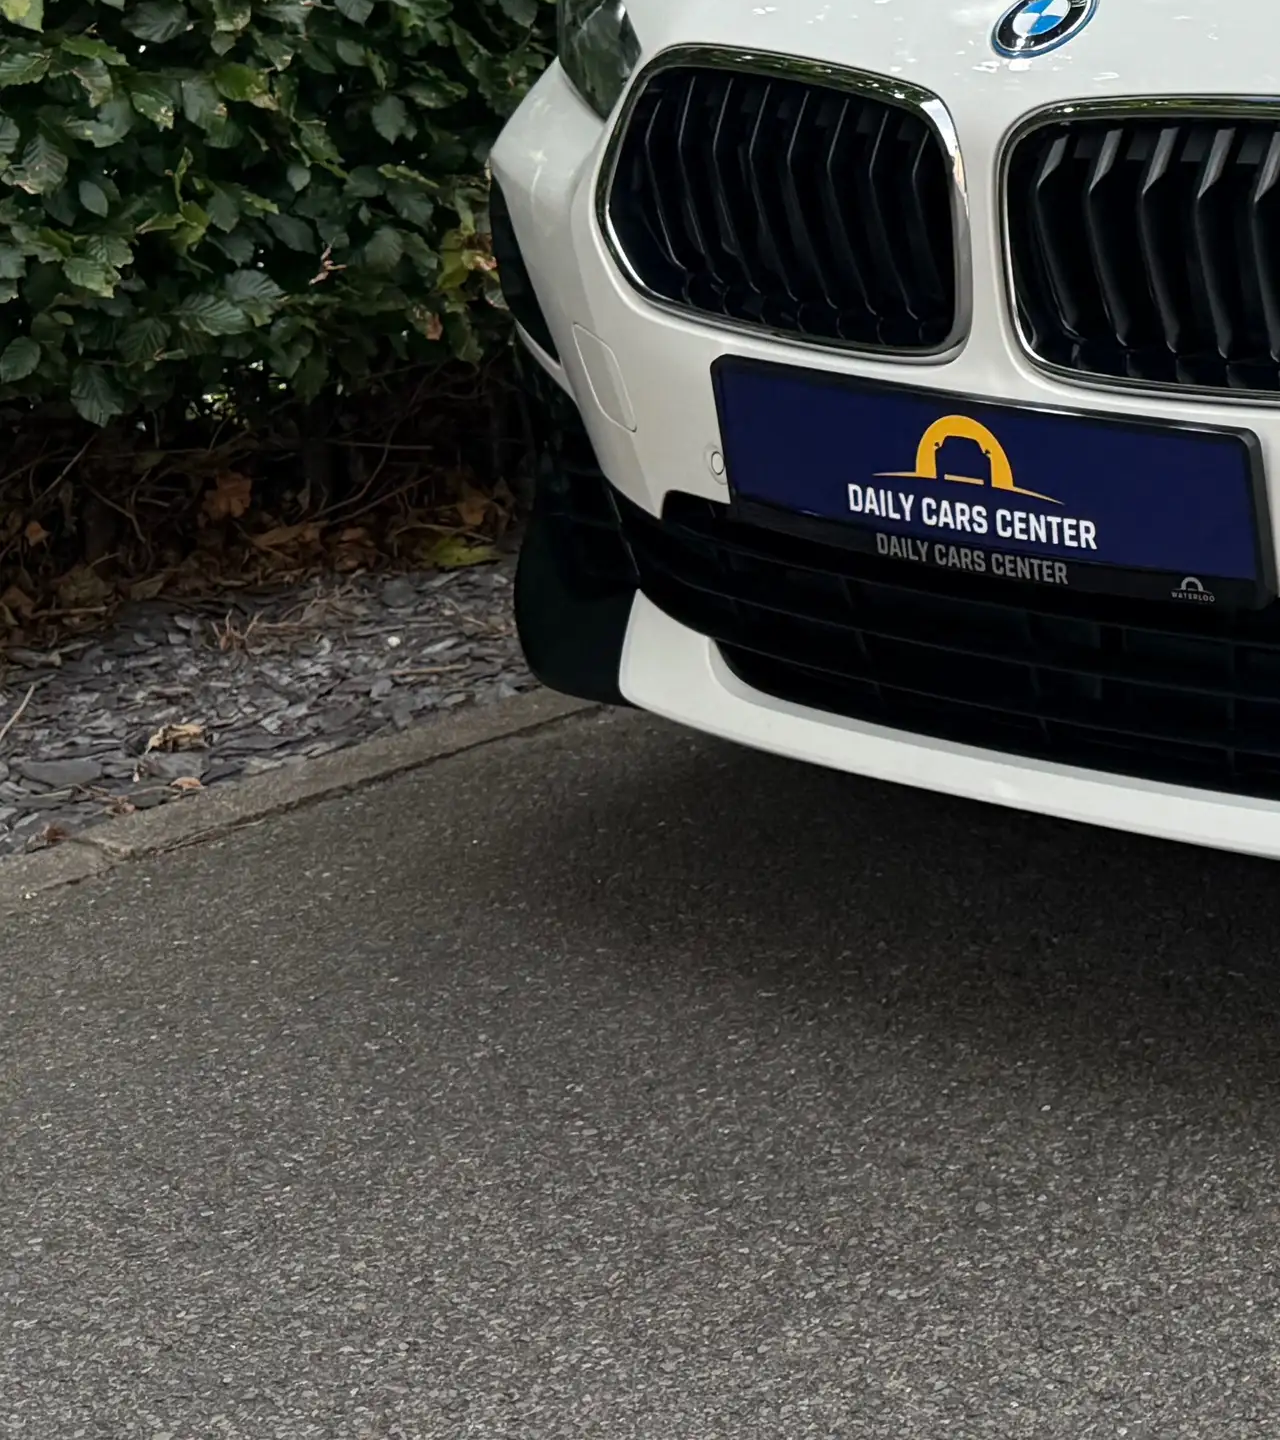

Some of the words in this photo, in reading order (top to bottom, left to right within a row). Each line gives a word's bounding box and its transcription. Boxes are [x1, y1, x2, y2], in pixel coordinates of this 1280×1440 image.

[848, 484, 914, 521] DAILY
[922, 498, 987, 533] CARS
[996, 509, 1097, 549] CENTER
[876, 533, 928, 562] DAILY
[935, 544, 985, 571] CARS
[992, 554, 1068, 584] CENTER
[1171, 591, 1216, 602] WATERLOO
